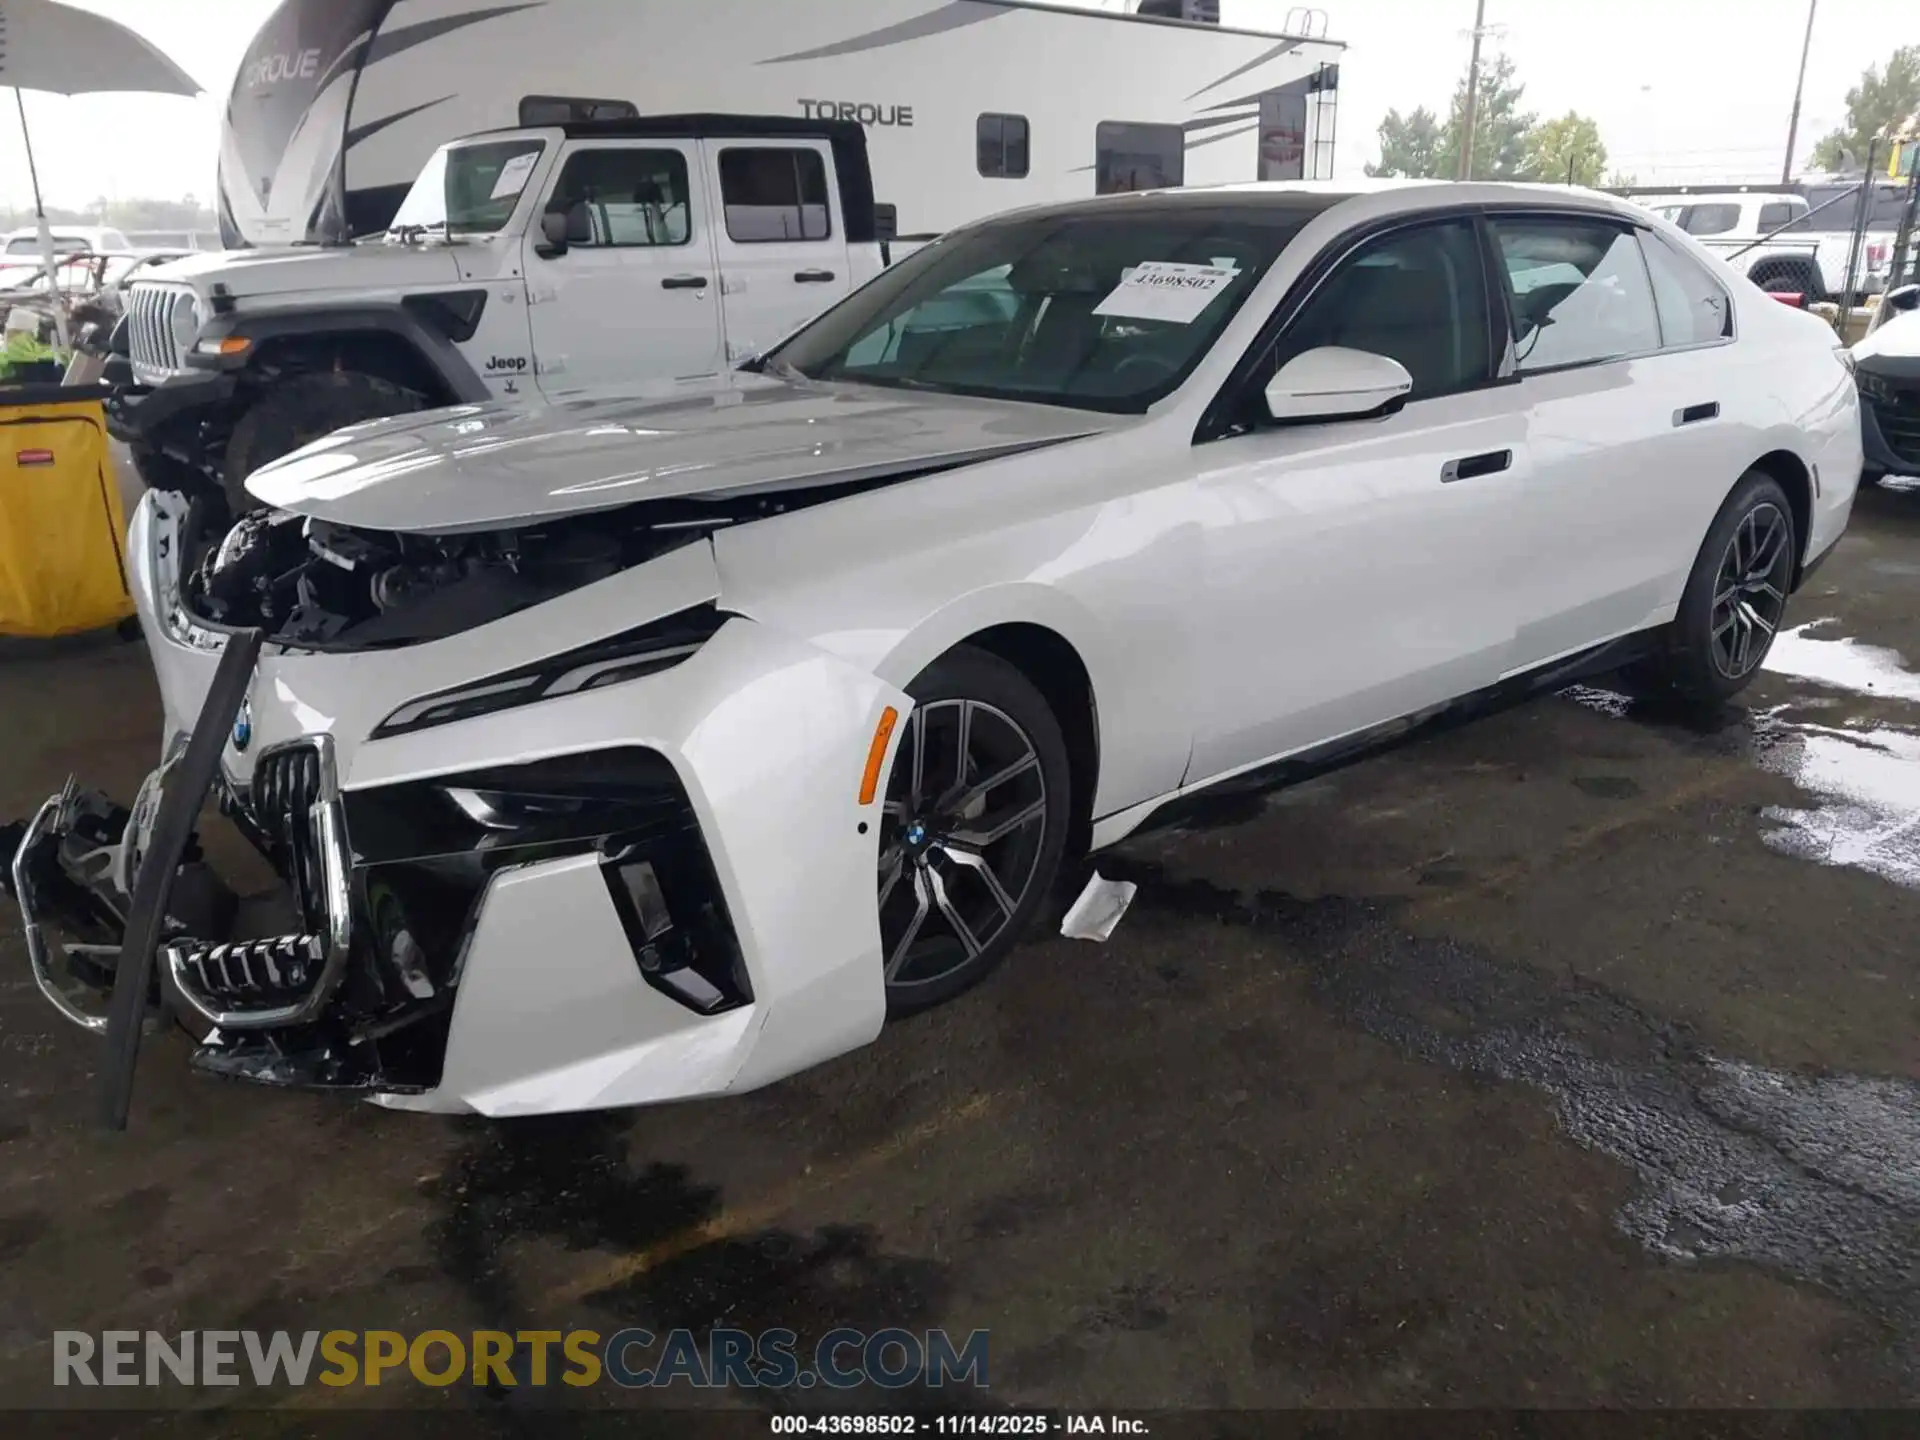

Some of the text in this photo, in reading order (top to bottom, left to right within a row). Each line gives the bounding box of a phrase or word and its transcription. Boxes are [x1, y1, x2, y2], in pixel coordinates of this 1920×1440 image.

[243, 48, 321, 88] ORQUE
[797, 98, 913, 127] TORQUE
[1135, 273, 1216, 290] 43698502
[485, 355, 526, 370] Jeep
